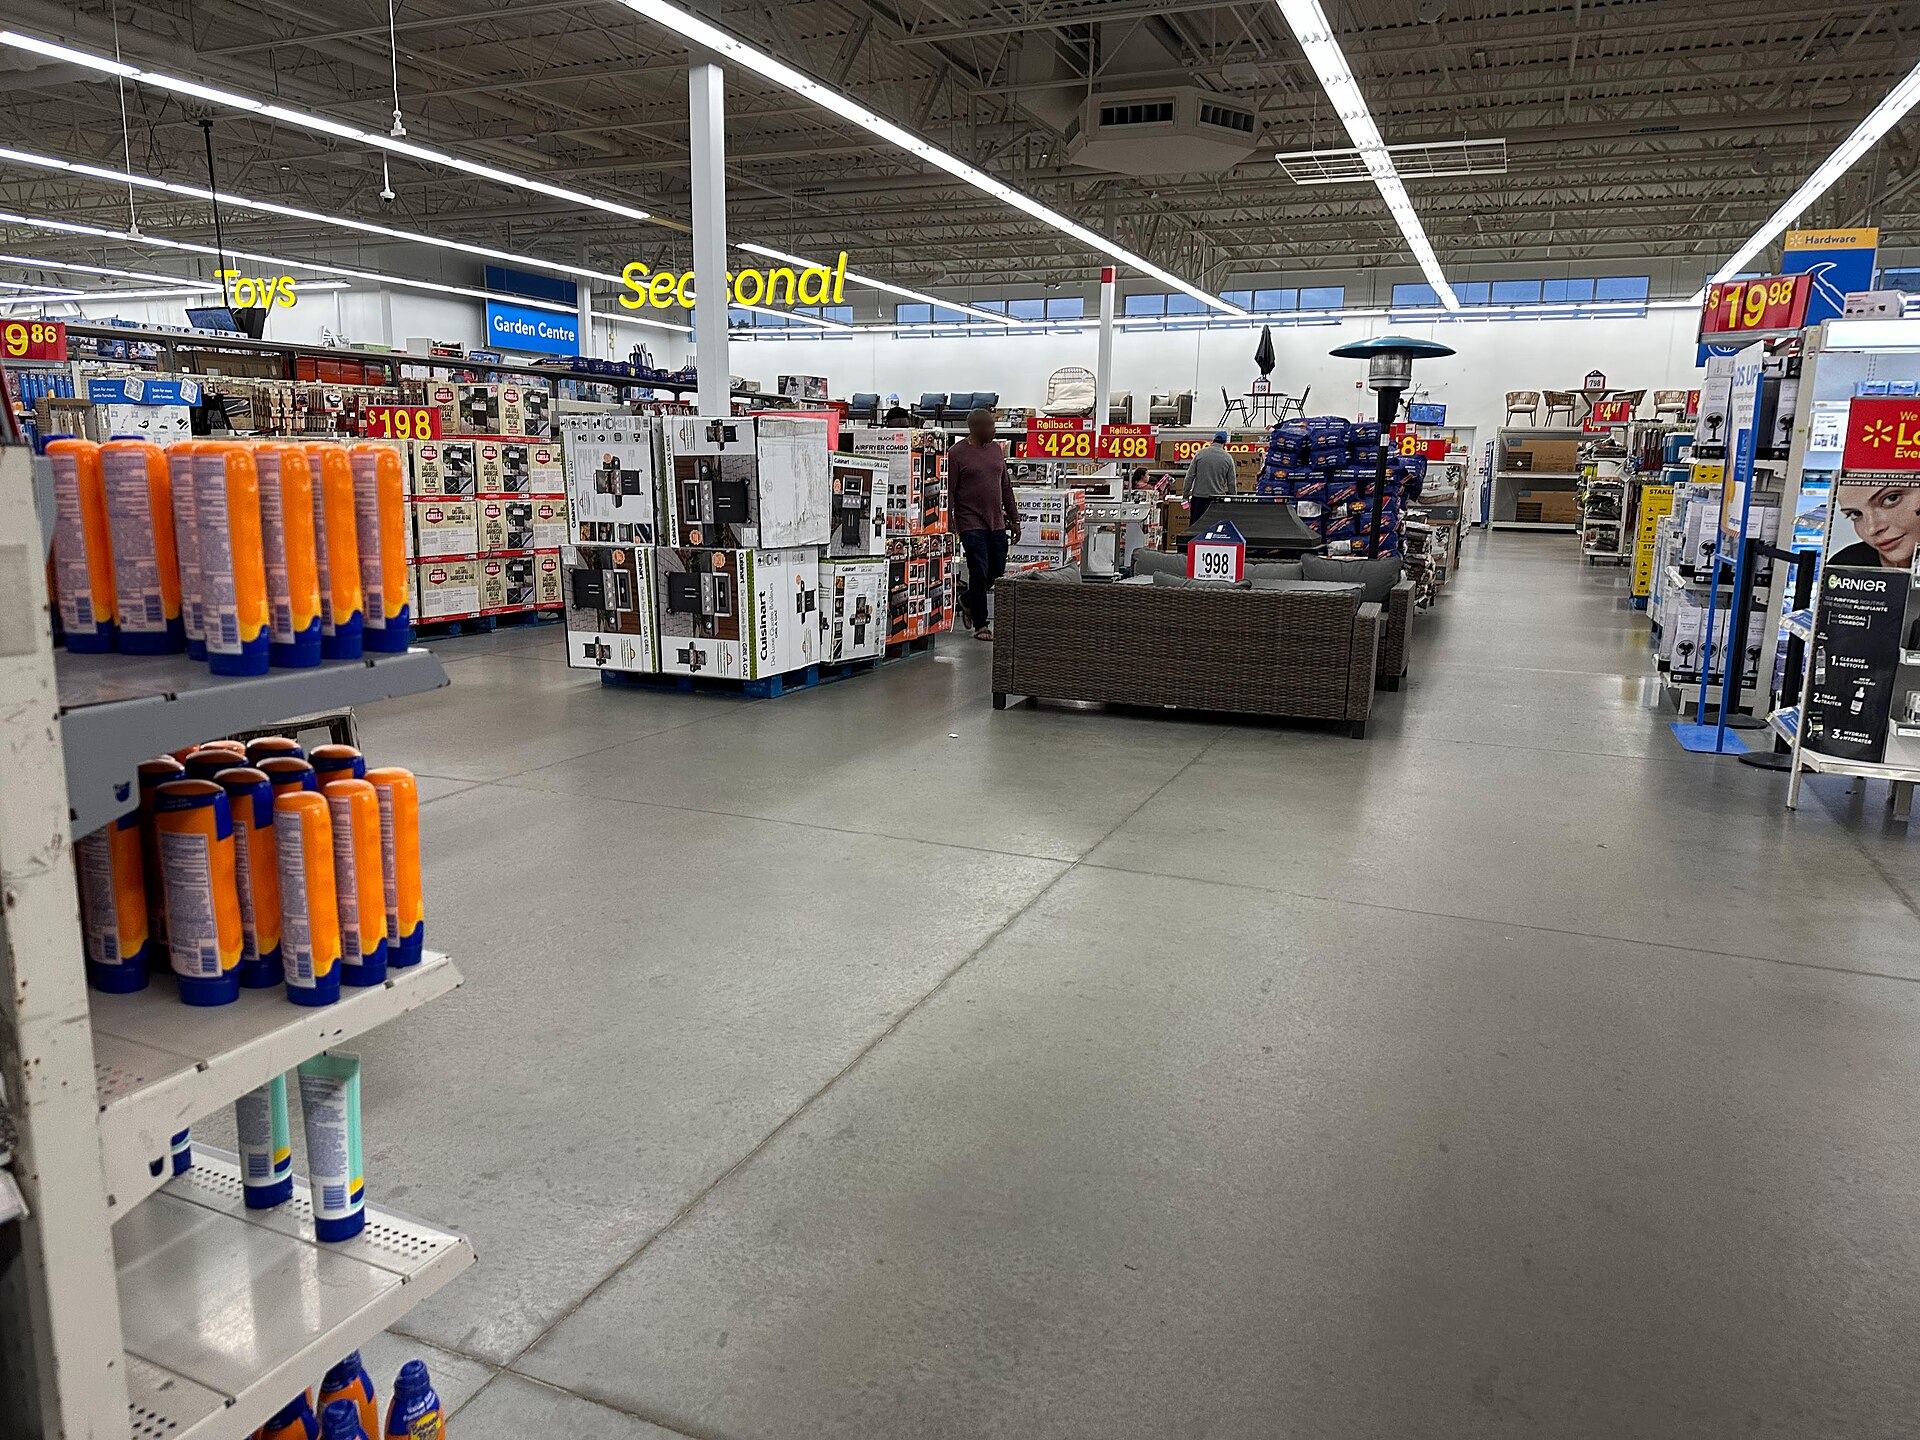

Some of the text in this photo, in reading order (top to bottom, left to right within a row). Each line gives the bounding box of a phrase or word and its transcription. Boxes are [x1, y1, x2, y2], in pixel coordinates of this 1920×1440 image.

[1805, 235, 1856, 244] Hardware
[618, 251, 847, 309] Seaonal
[494, 316, 574, 341] Garden Centre
[1900, 411, 1918, 420] We
[1036, 420, 1073, 429] Rollback
[1110, 426, 1141, 435] Rollback
[758, 591, 768, 661] Cuisinart
[771, 656, 775, 666] De
[1844, 730, 1869, 738] HYDRATE
[1843, 736, 1872, 744] HYDRATER
